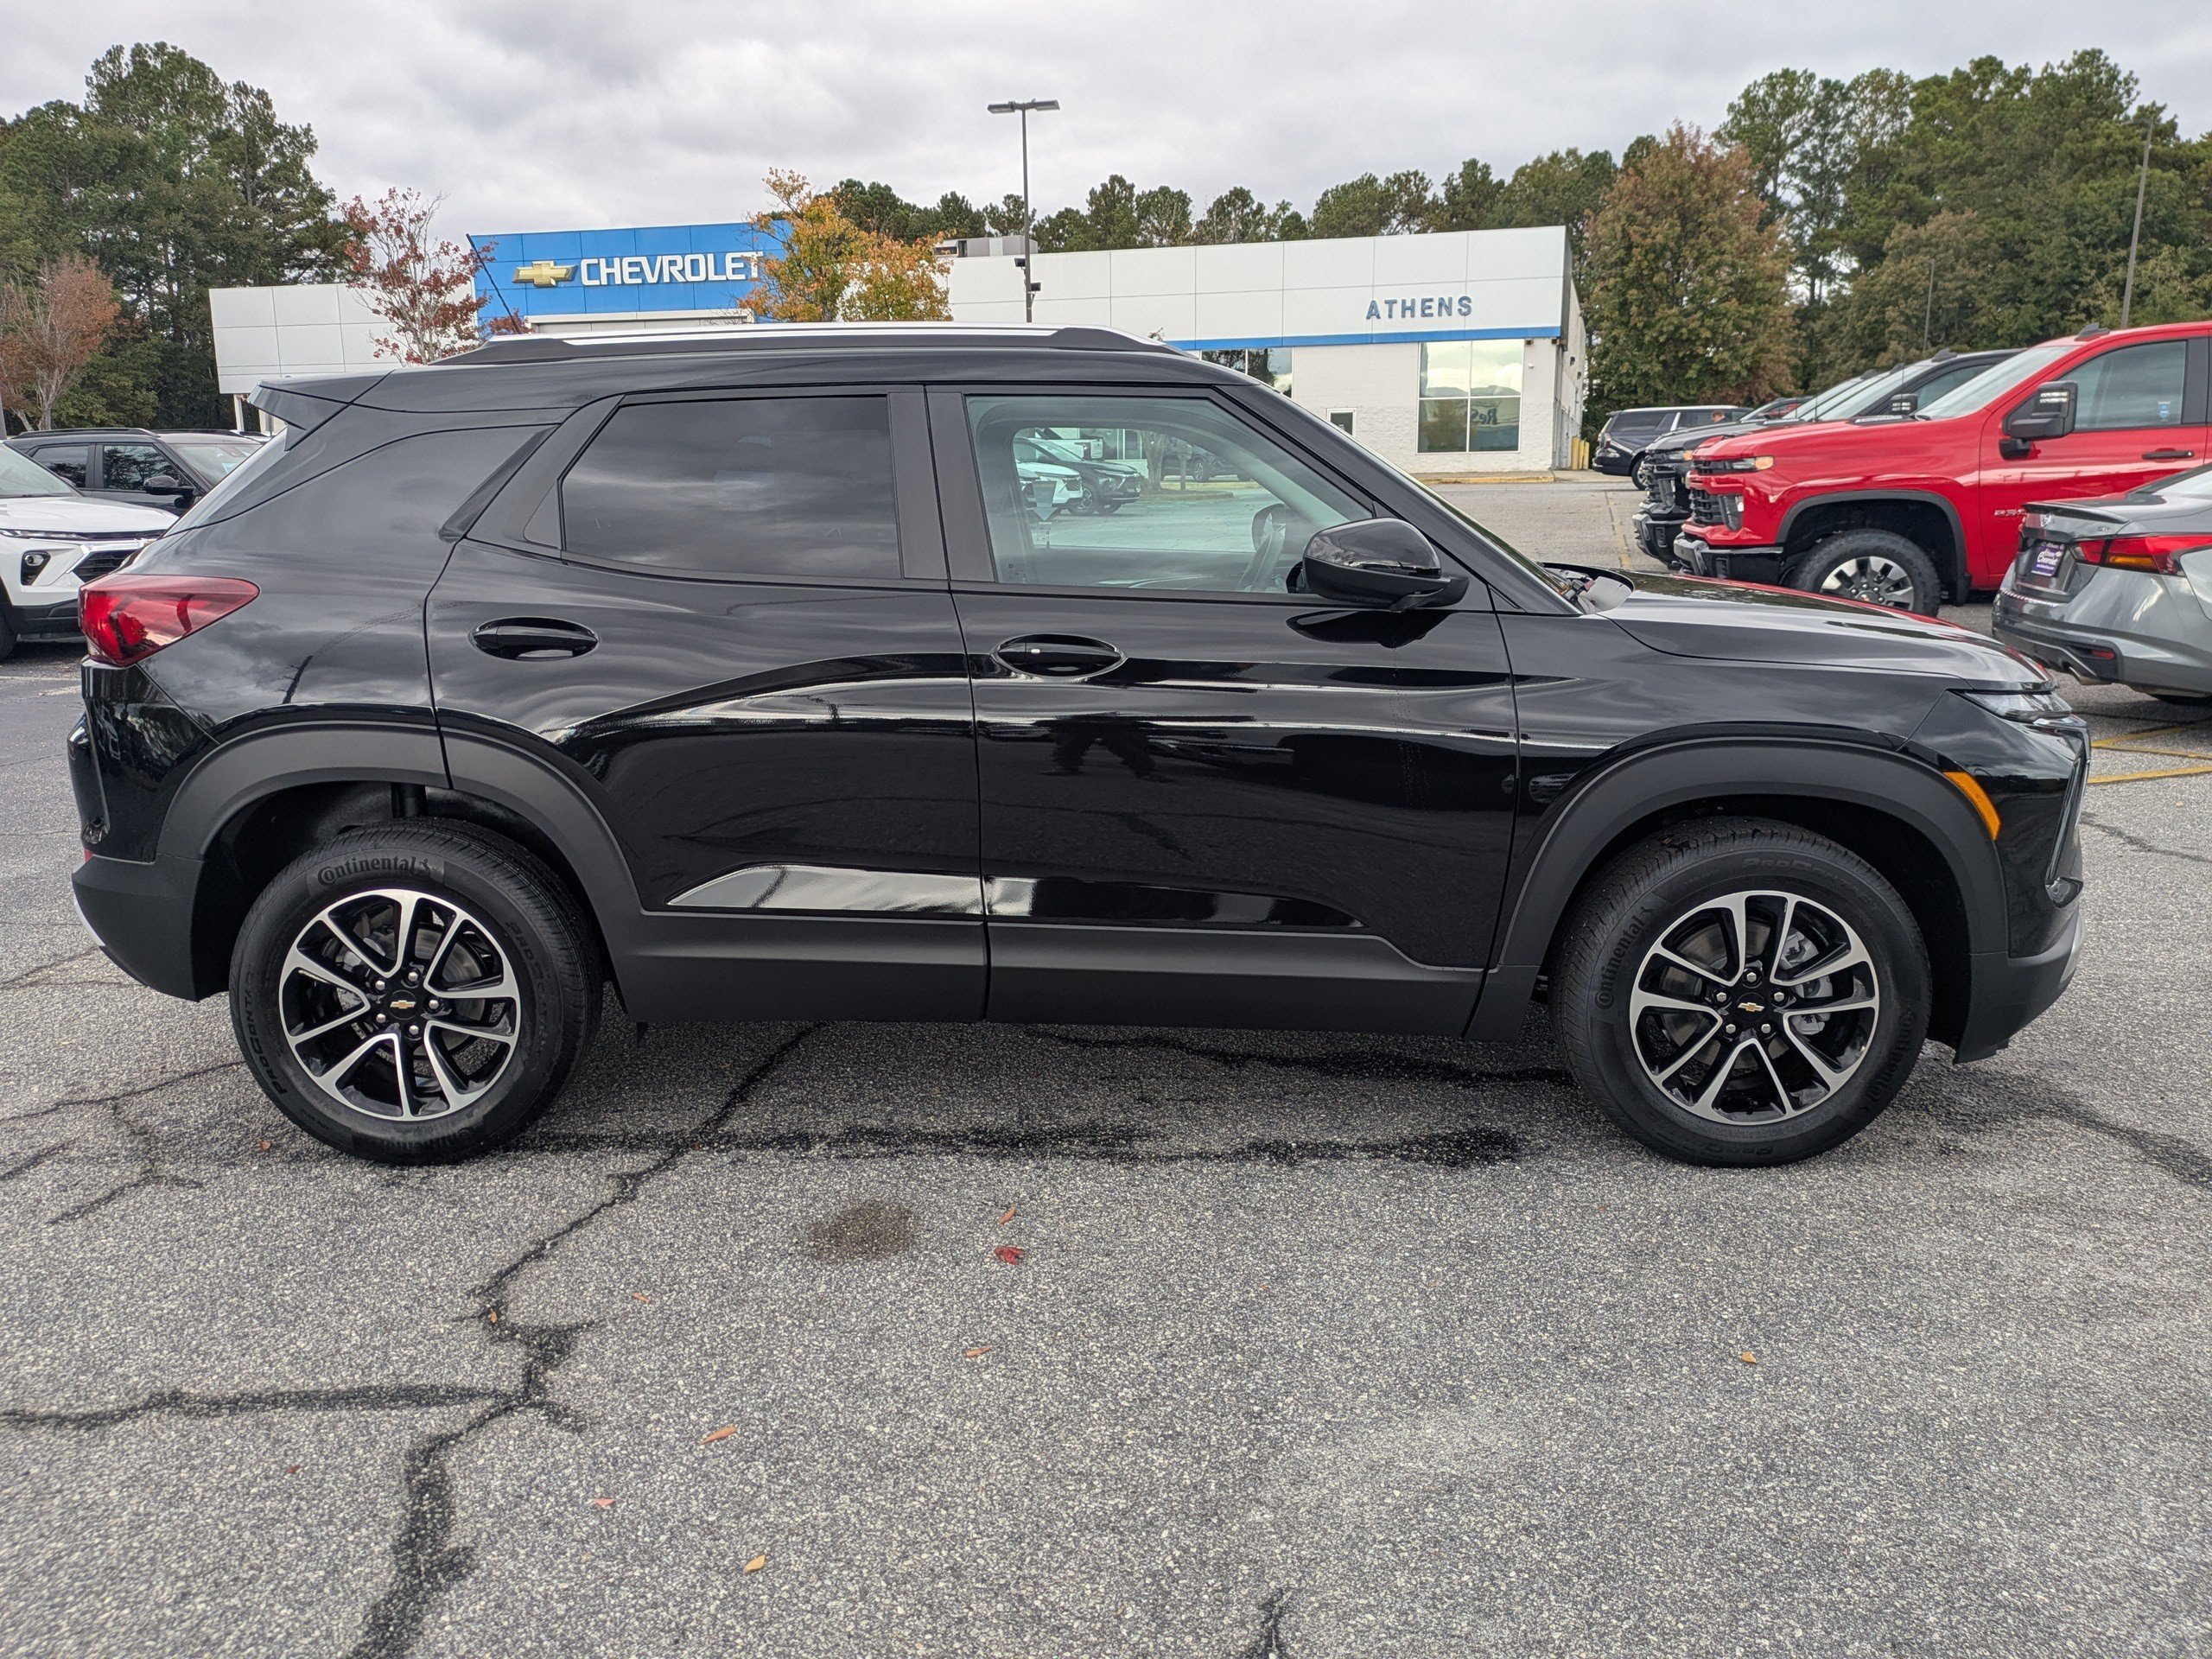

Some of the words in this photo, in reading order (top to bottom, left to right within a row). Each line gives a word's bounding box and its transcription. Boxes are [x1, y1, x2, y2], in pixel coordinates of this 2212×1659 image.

[581, 251, 764, 286] CHEVROLET
[1365, 295, 1472, 320] ATHENS
[316, 855, 417, 887] Continental
[1594, 915, 1647, 1010] Continental
